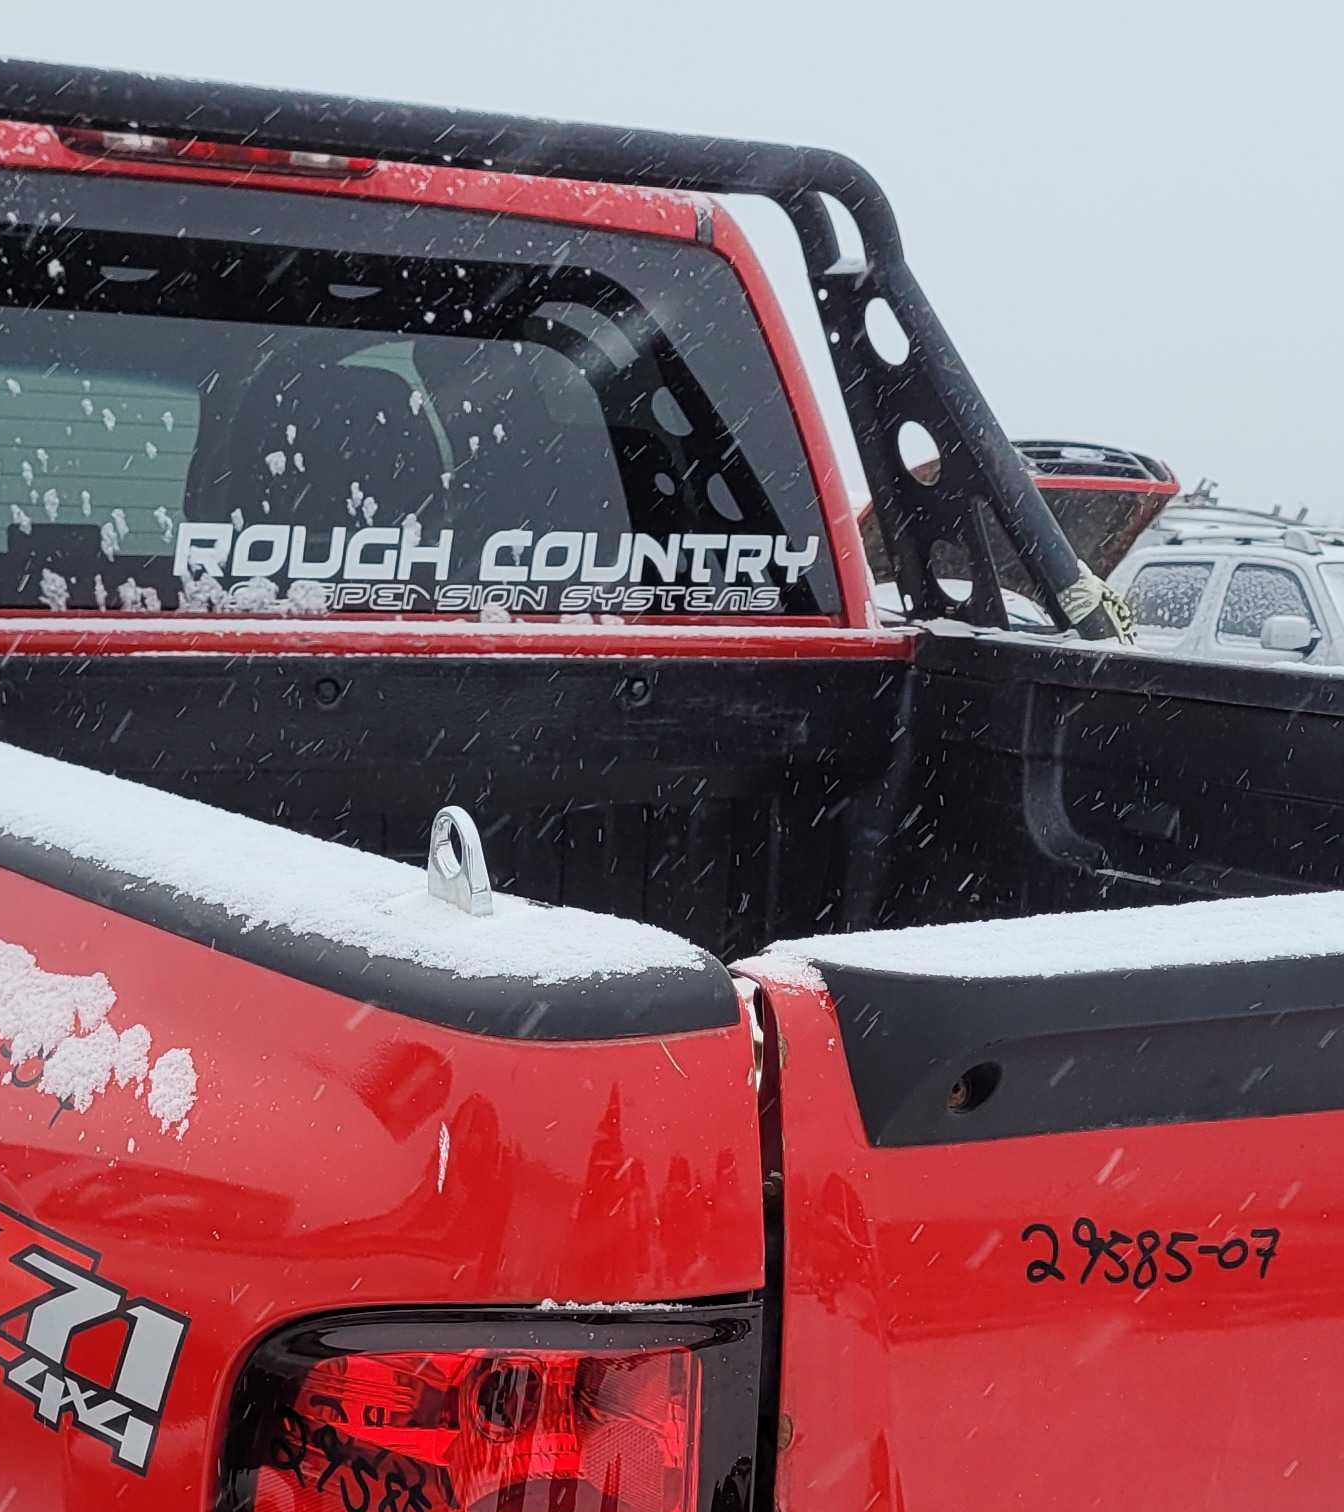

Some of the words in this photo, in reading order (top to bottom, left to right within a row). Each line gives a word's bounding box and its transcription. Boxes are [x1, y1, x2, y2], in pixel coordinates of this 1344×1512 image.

[173, 523, 454, 580] ROUGH
[479, 529, 819, 582] COUNTRY
[559, 585, 780, 612] SYSTEMS
[1020, 1217, 1282, 1291] 29585-07
